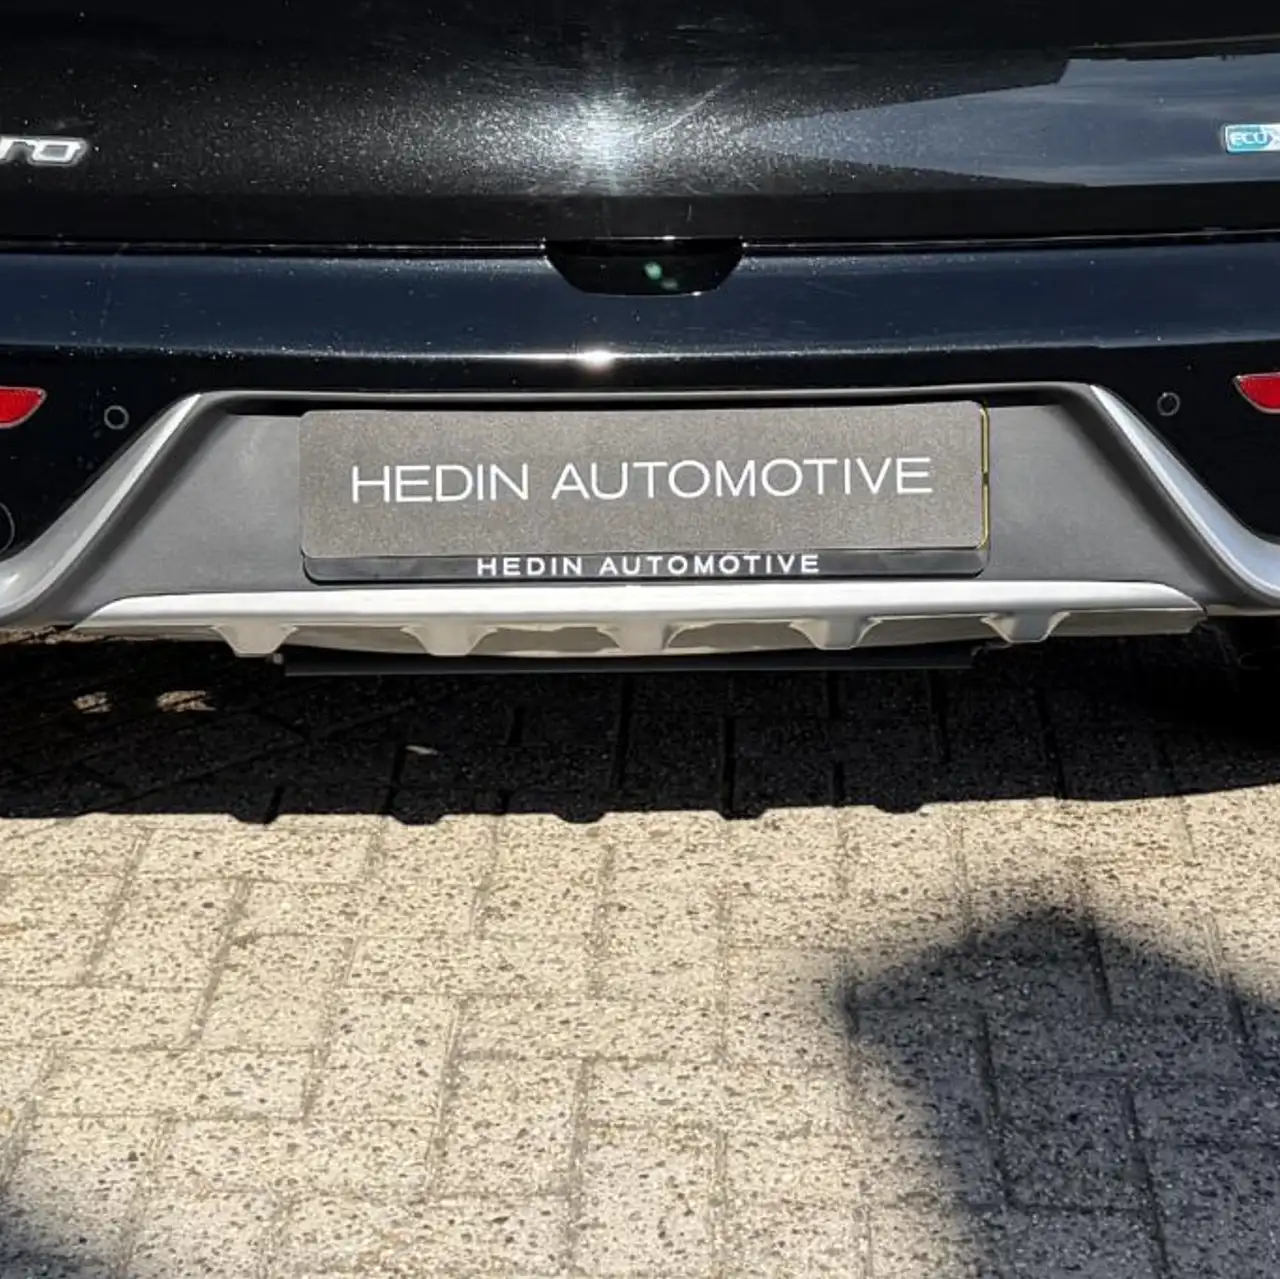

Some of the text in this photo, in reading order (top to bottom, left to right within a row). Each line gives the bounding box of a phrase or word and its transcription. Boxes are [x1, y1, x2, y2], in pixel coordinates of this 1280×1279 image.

[351, 456, 934, 504] HEDIN AUTOMOTIVE
[477, 554, 820, 577] HEDIN AUTOMOTIVE
